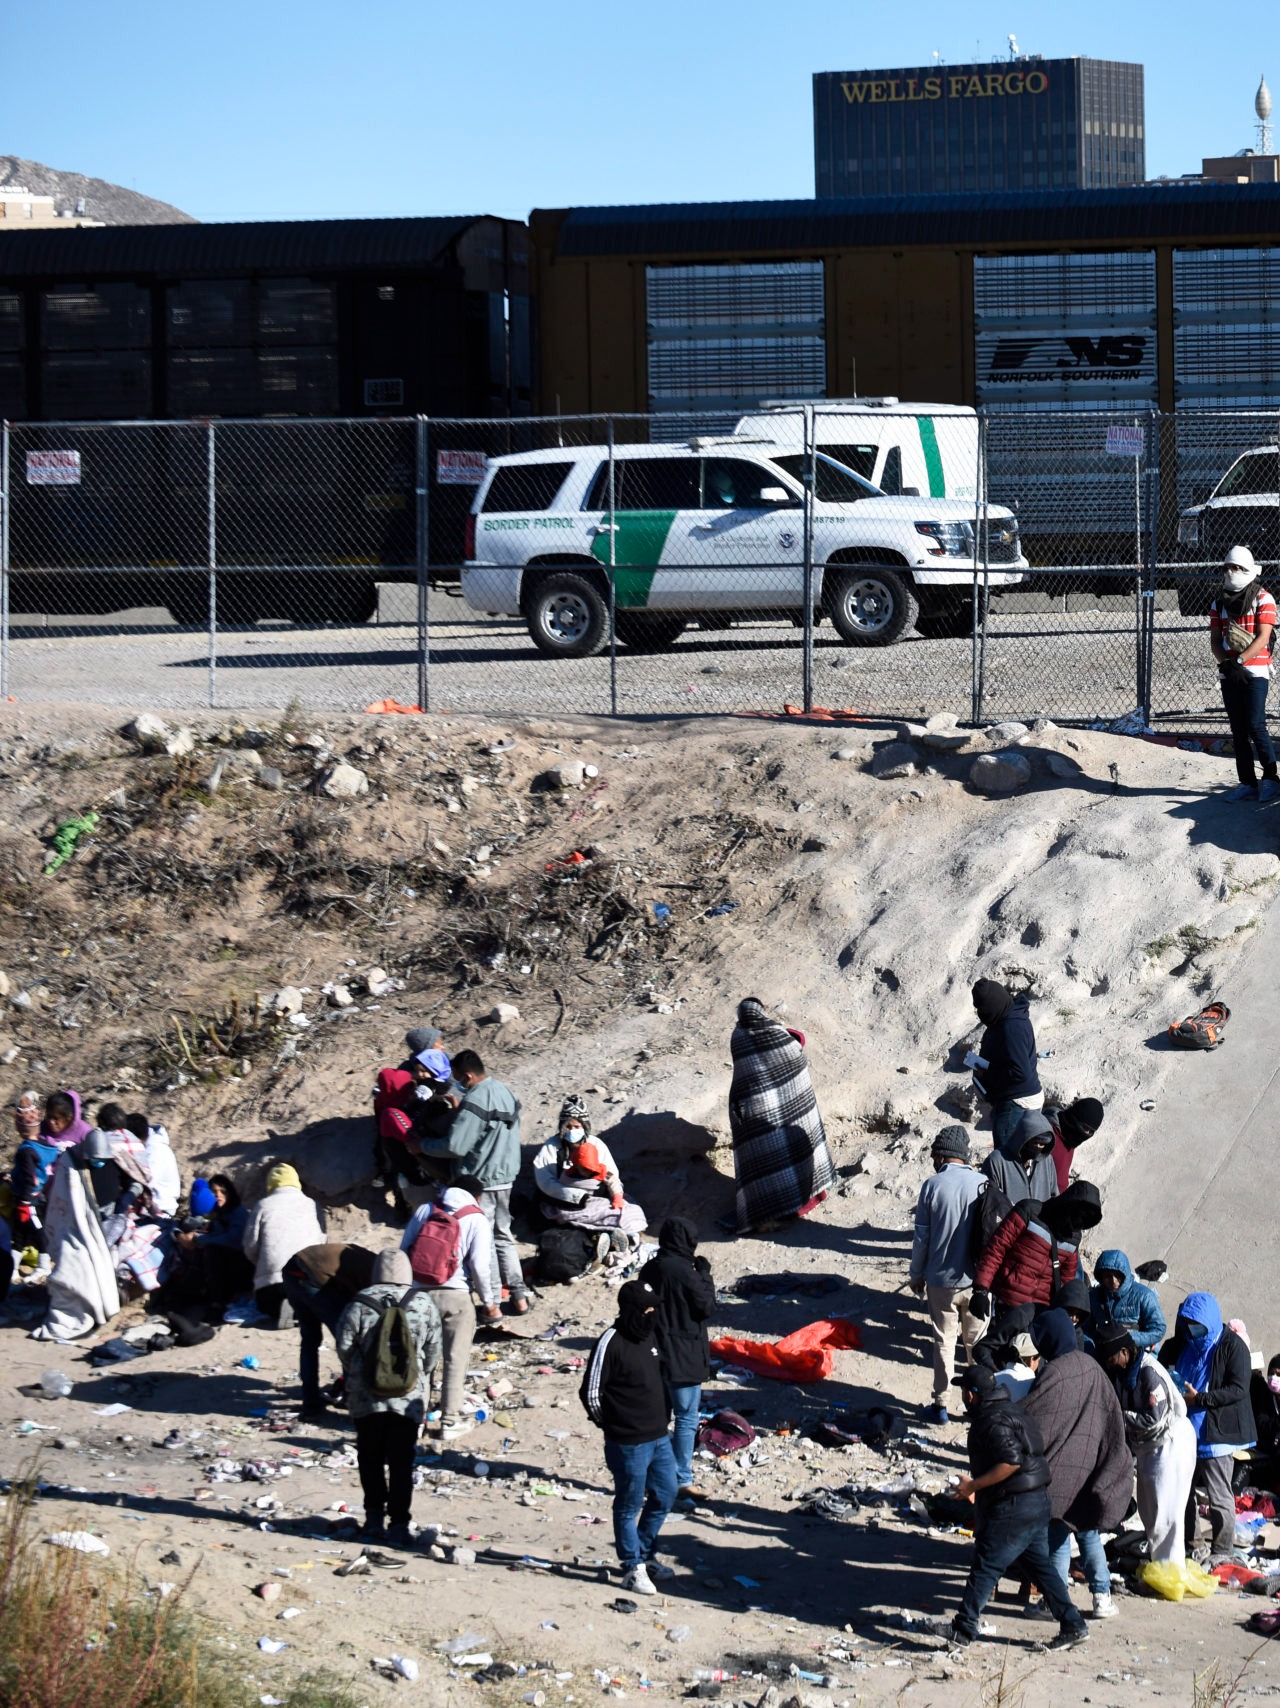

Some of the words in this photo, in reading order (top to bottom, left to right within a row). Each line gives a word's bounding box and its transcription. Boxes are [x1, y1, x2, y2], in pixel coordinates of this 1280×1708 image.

[841, 77, 942, 104] WELLS
[948, 71, 1049, 98] FARGO
[987, 371, 1054, 383] NORFOLK
[1061, 369, 1141, 382] SOUTHERN
[1109, 426, 1143, 441] NATIONAL
[484, 518, 530, 532] BORDER
[534, 517, 575, 529] PATROL
